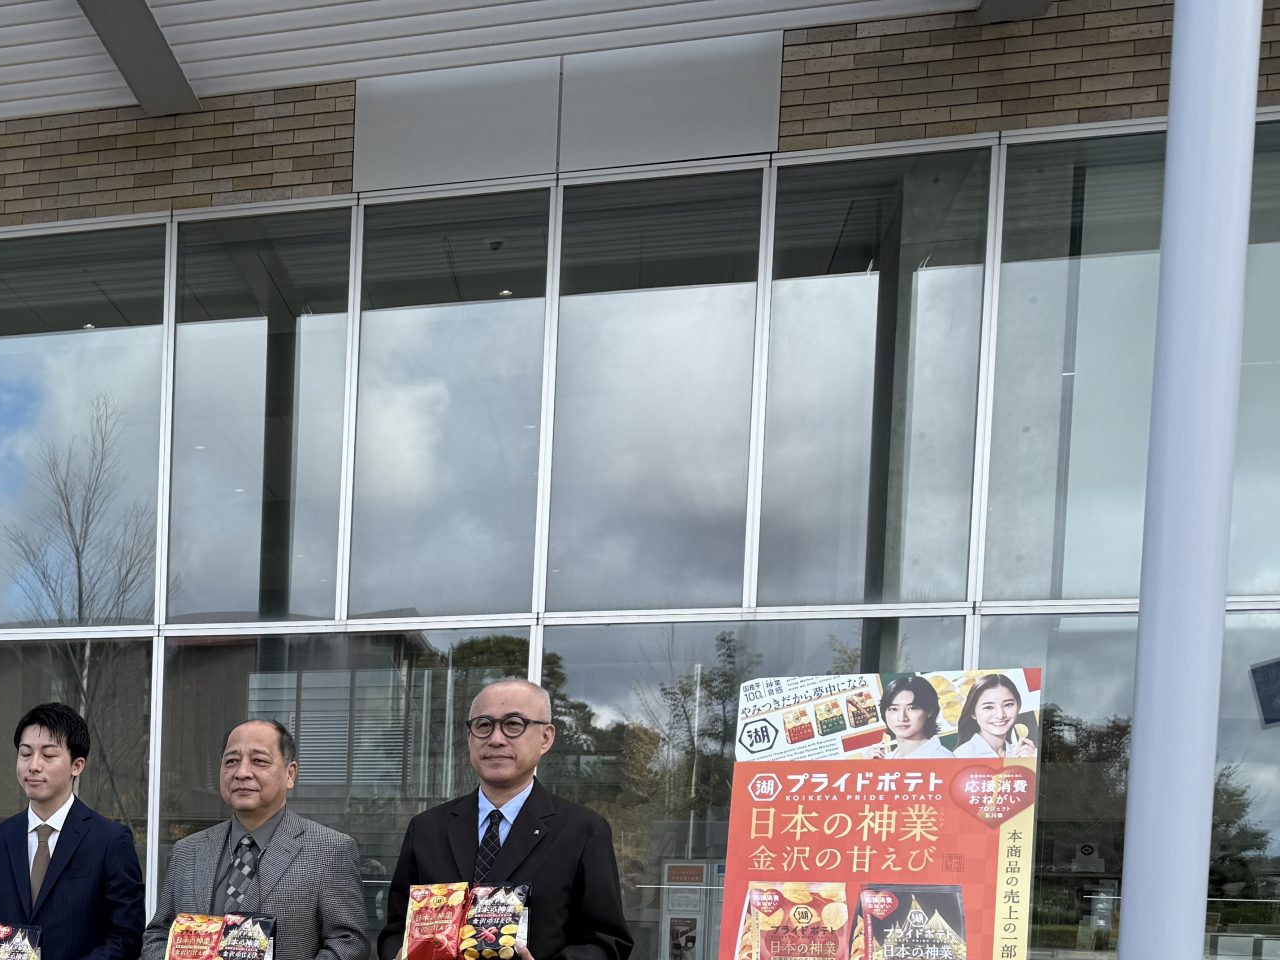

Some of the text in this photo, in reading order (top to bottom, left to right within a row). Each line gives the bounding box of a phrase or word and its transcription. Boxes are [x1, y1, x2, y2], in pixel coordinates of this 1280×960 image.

[741, 676, 867, 718] やみつきだから夢中になる
[747, 725, 771, 747] 湖
[787, 771, 944, 793] プライドポテト
[965, 779, 1028, 793] 応援消費
[969, 794, 1021, 805] おねがい
[749, 803, 940, 842] 日本の神業
[747, 844, 937, 873] 金沢の甘えび
[771, 941, 837, 954] 日本の神業
[884, 944, 953, 959] 日本の神業
